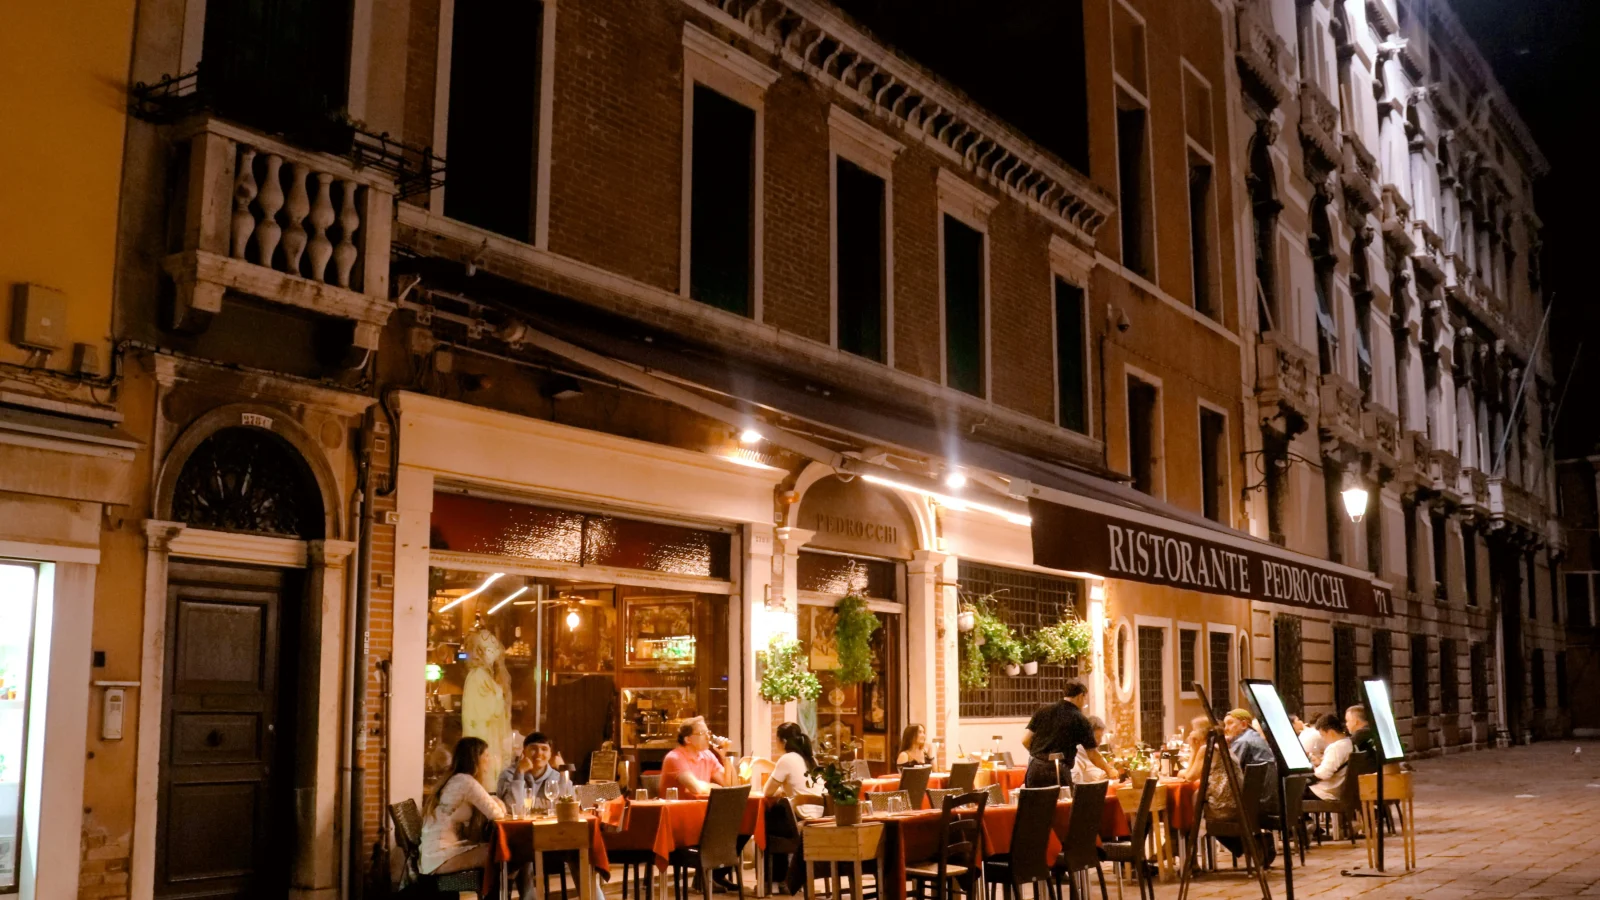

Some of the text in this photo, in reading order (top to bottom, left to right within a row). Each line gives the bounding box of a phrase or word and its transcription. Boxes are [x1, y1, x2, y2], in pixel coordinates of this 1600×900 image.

[816, 513, 897, 544] PEDROCCHI
[1107, 524, 1349, 609] RISTORANTE PEDROCCHI
